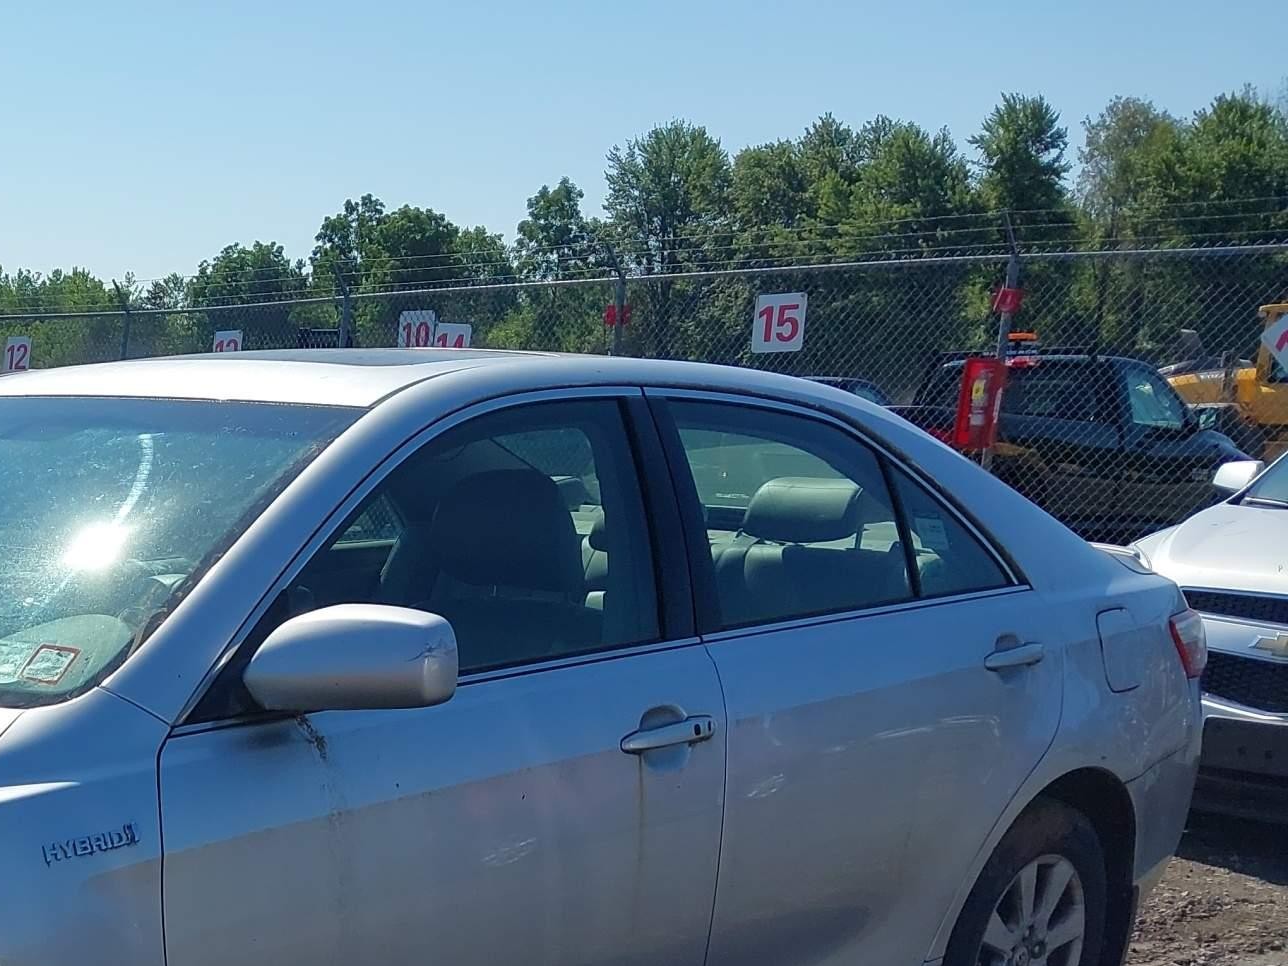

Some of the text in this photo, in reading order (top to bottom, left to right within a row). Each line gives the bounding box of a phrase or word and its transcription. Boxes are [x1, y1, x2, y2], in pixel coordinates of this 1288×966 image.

[403, 321, 430, 348] 10
[759, 303, 800, 343] 15
[7, 343, 28, 370] 12
[42, 826, 132, 867] HYBRID
